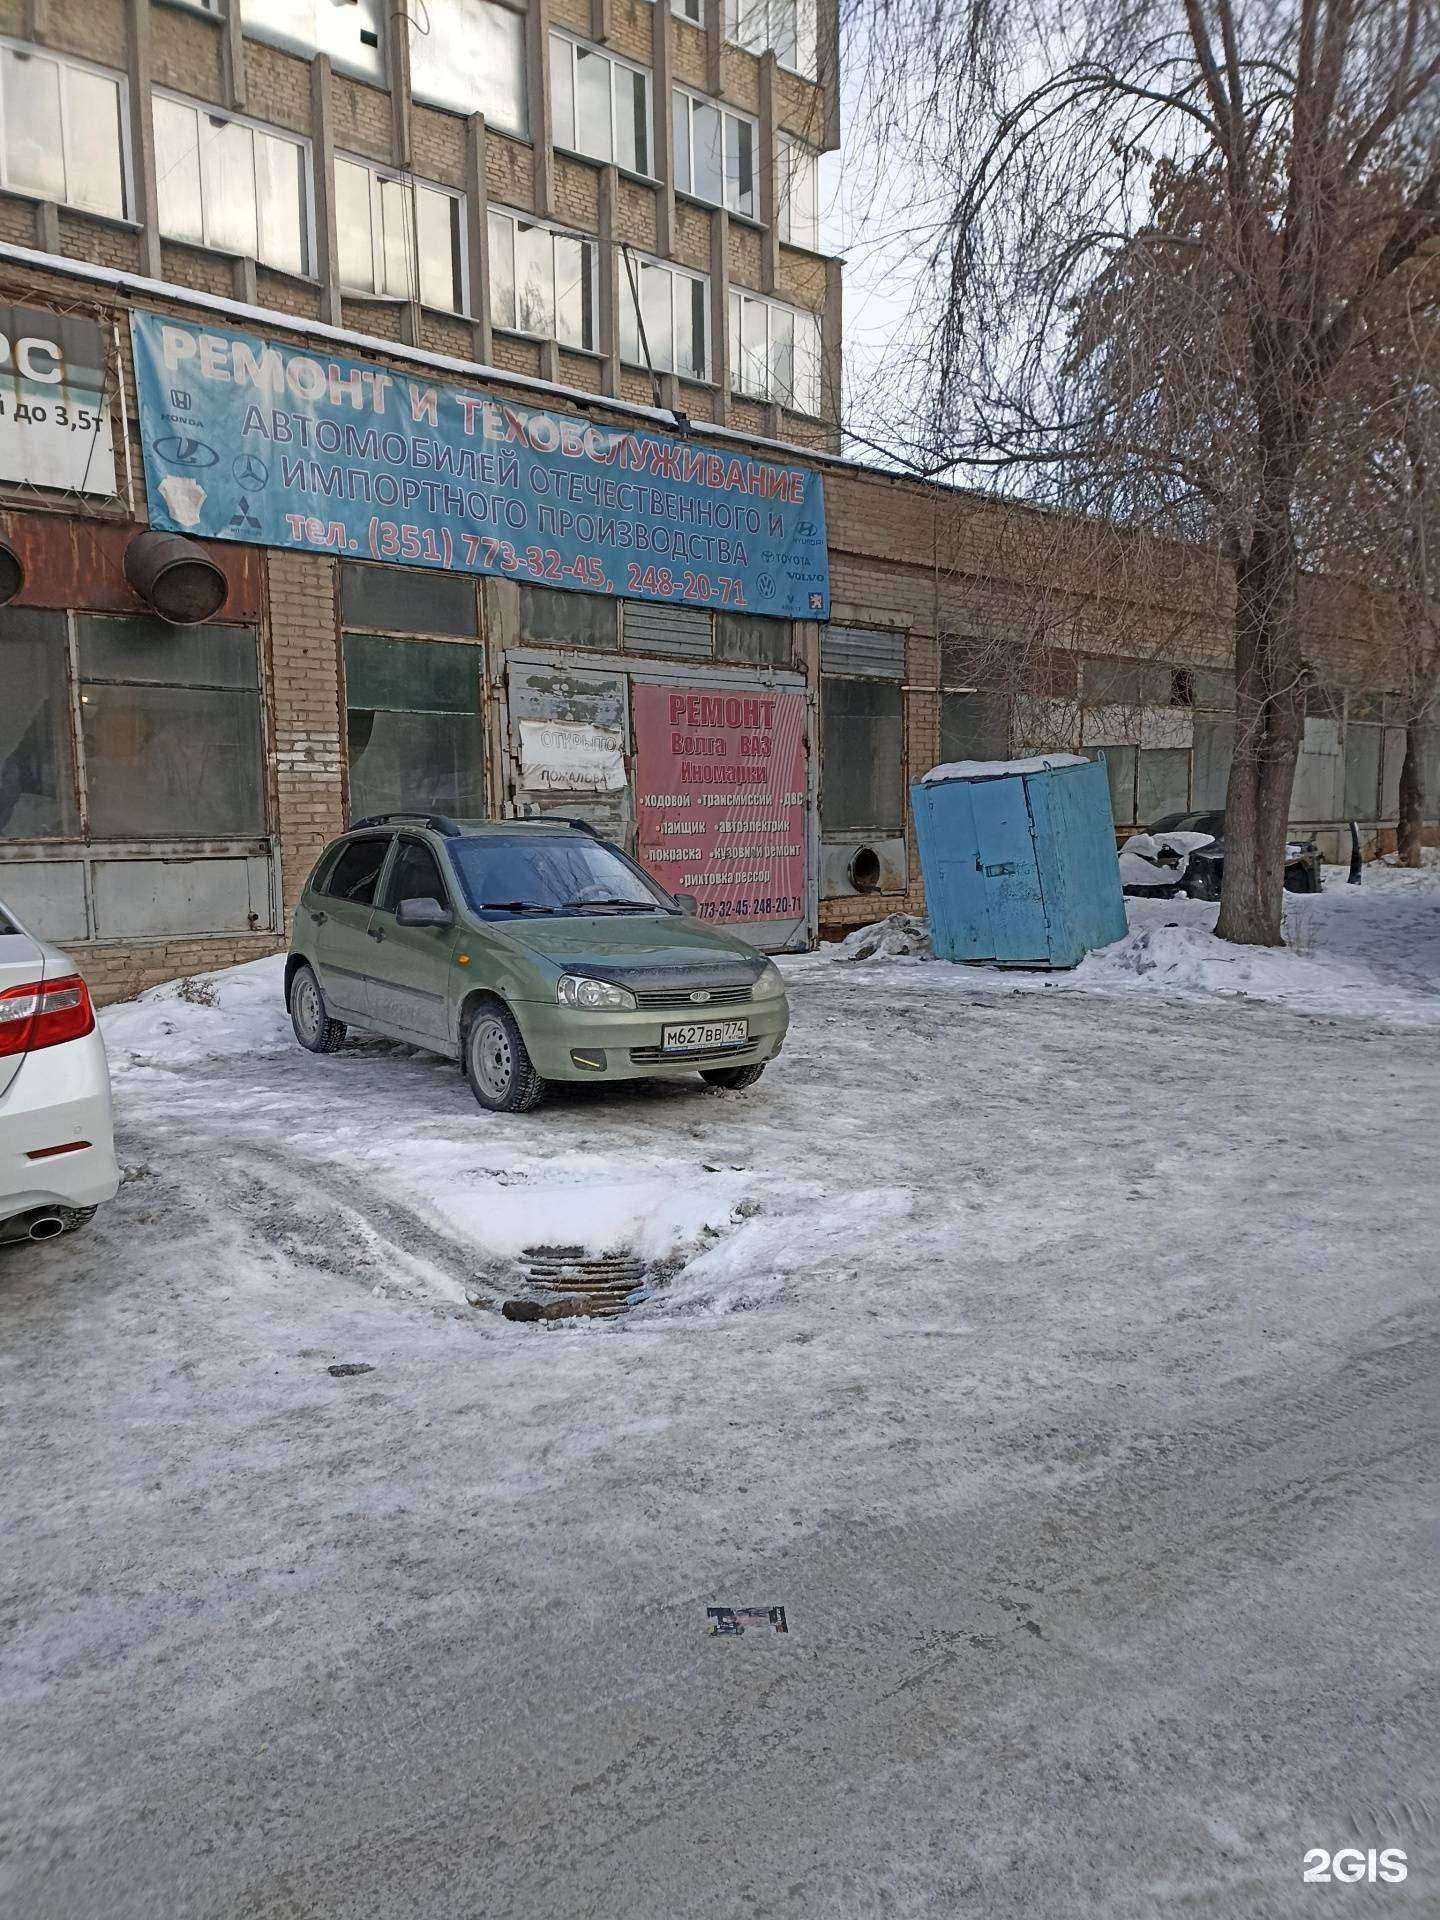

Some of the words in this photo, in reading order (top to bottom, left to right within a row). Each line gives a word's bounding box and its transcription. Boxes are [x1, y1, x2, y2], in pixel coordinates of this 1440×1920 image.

[13, 403, 47, 425] до
[54, 405, 103, 432] 3,5т
[161, 325, 393, 415] РЕМОНТ
[408, 385, 439, 428] И
[456, 394, 806, 504] ТЕХОБСЛУЖИВАНИЕ
[161, 413, 204, 428] HONDA
[241, 404, 520, 489] АВТОМОБИЛЕЙ
[529, 464, 761, 535] ОТЕЧЕСТВЕННОГО
[768, 511, 784, 539] И
[280, 454, 528, 530] ИМПОРТНОГО
[537, 504, 749, 567] ПРОИЗВОДСТВА
[285, 514, 358, 549] тел.
[368, 517, 453, 569] (351)
[461, 533, 614, 592] 773-32-45,
[627, 562, 749, 606] 248-20-71
[776, 553, 811, 566] TOYOTA
[786, 571, 824, 582] VOLVO
[669, 694, 776, 729] РЕМОНТ
[671, 732, 726, 756] Волга
[740, 735, 772, 757] ВАЗ
[681, 760, 767, 785] Иномарки
[644, 792, 691, 808] ходовой
[701, 793, 772, 807] трансмиссии
[718, 820, 791, 834] автоэлектрик
[649, 848, 702, 862] покраска
[764, 844, 801, 858] ремонт
[734, 870, 770, 884] рессор
[753, 896, 801, 915] 248-20-71
